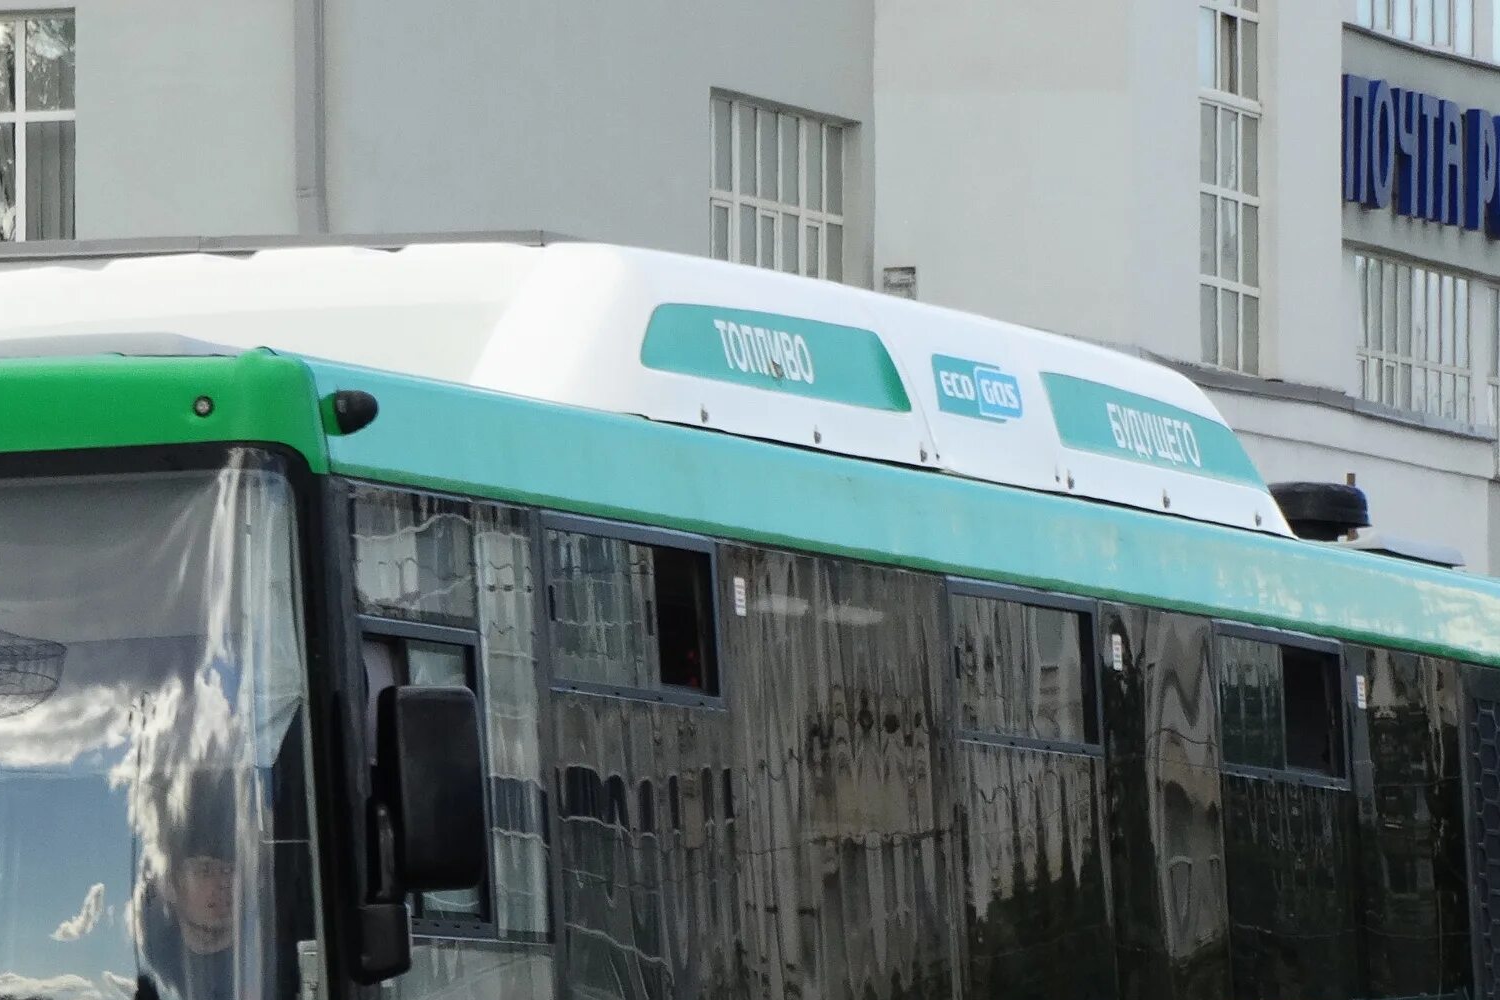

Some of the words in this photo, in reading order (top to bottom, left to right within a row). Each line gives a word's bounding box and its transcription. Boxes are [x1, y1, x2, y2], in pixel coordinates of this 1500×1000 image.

[1341, 74, 1463, 227] ПОЧТА
[713, 319, 815, 385] ТОПЛИВО
[939, 369, 976, 401] ECO
[1106, 402, 1201, 468] БУДУЩЕГО
